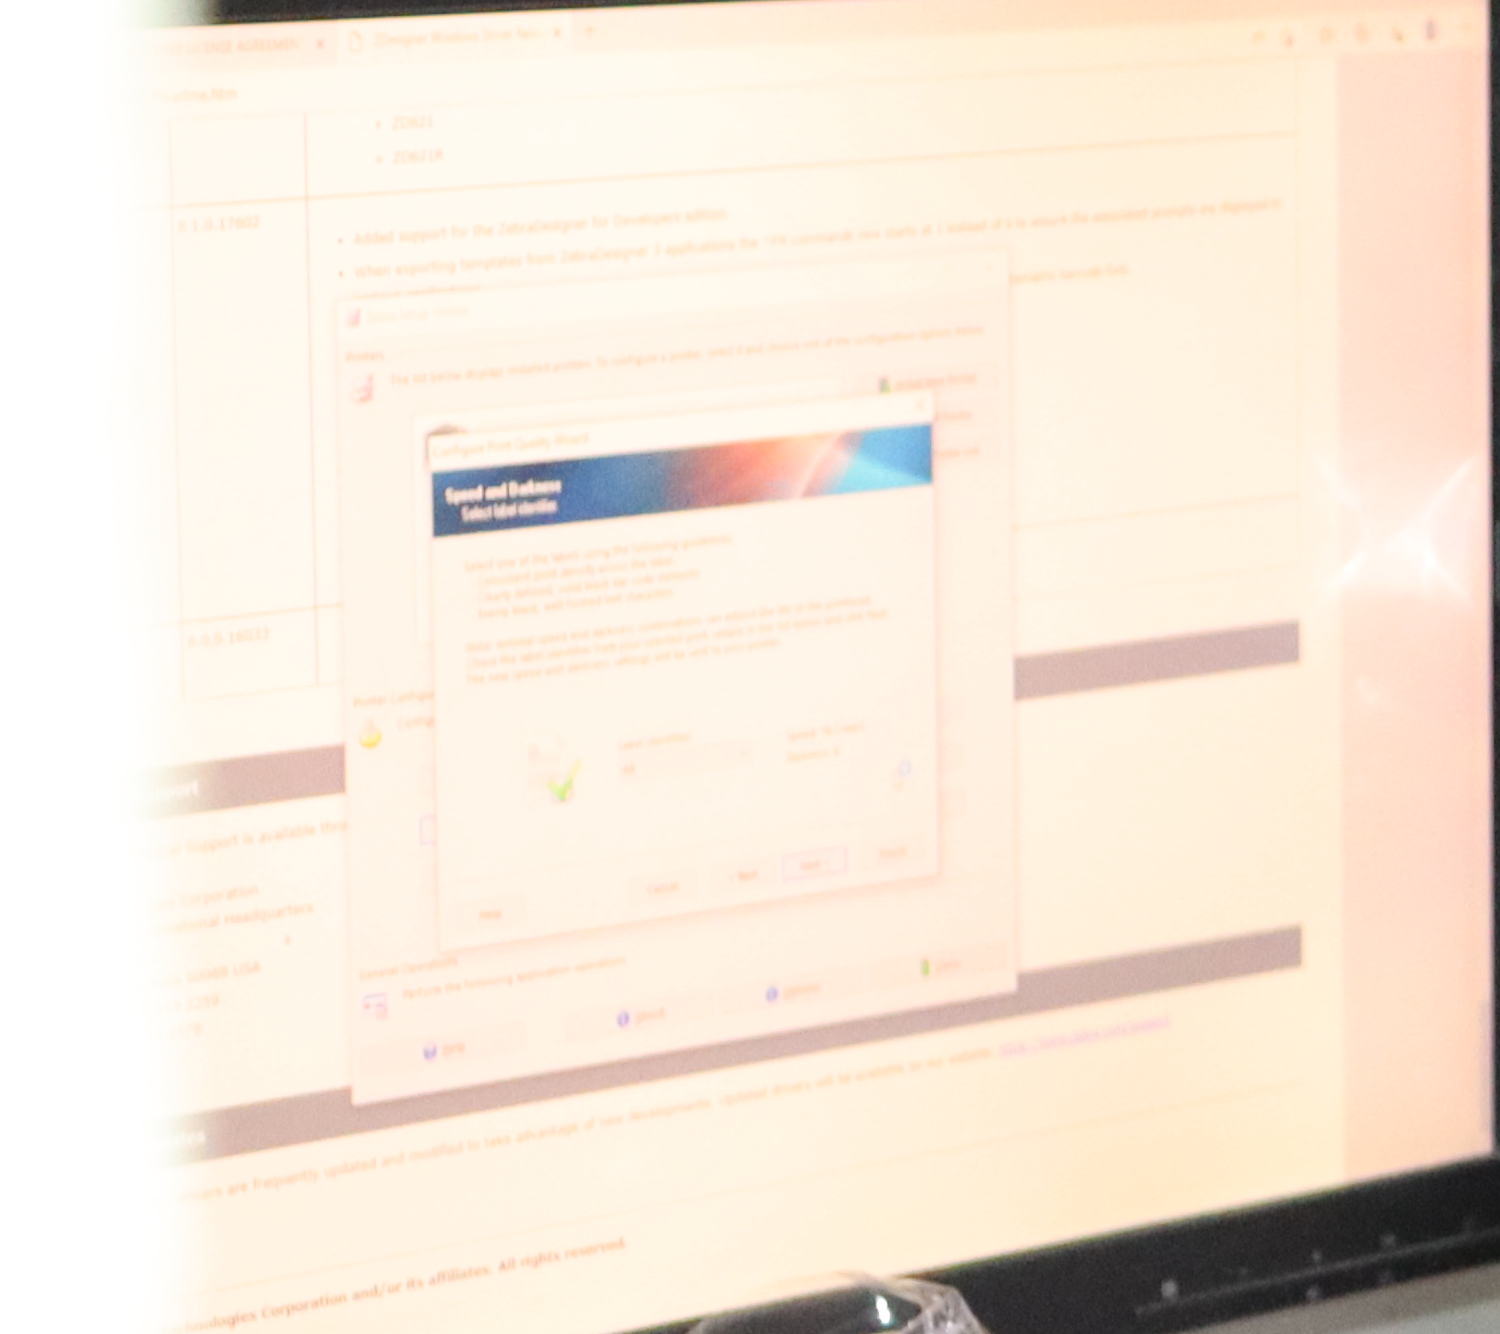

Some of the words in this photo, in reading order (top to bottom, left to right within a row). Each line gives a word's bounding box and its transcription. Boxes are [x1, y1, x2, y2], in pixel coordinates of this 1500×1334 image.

[353, 230, 394, 246] Added
[397, 227, 447, 245] support
[450, 224, 468, 239] for
[472, 223, 494, 237] the
[498, 217, 588, 236] ZebraDesigner
[353, 263, 391, 279] When
[394, 259, 457, 278] exporting
[460, 254, 523, 271] templates
[526, 250, 557, 266] from
[445, 484, 482, 505] Speed
[486, 482, 506, 500] and
[509, 477, 561, 497] Darkness
[180, 884, 259, 907] Corporation
[223, 901, 314, 926] Headquarters
[226, 1181, 249, 1196] are
[252, 1167, 320, 1193] frequently
[324, 1156, 377, 1179] updated
[380, 1151, 405, 1168] and
[409, 1139, 464, 1163] modified
[261, 1291, 347, 1320] Corporation
[352, 1280, 402, 1302] and/or
[405, 1275, 425, 1292] its
[498, 1257, 517, 1272] All
[519, 1249, 560, 1271] rights
